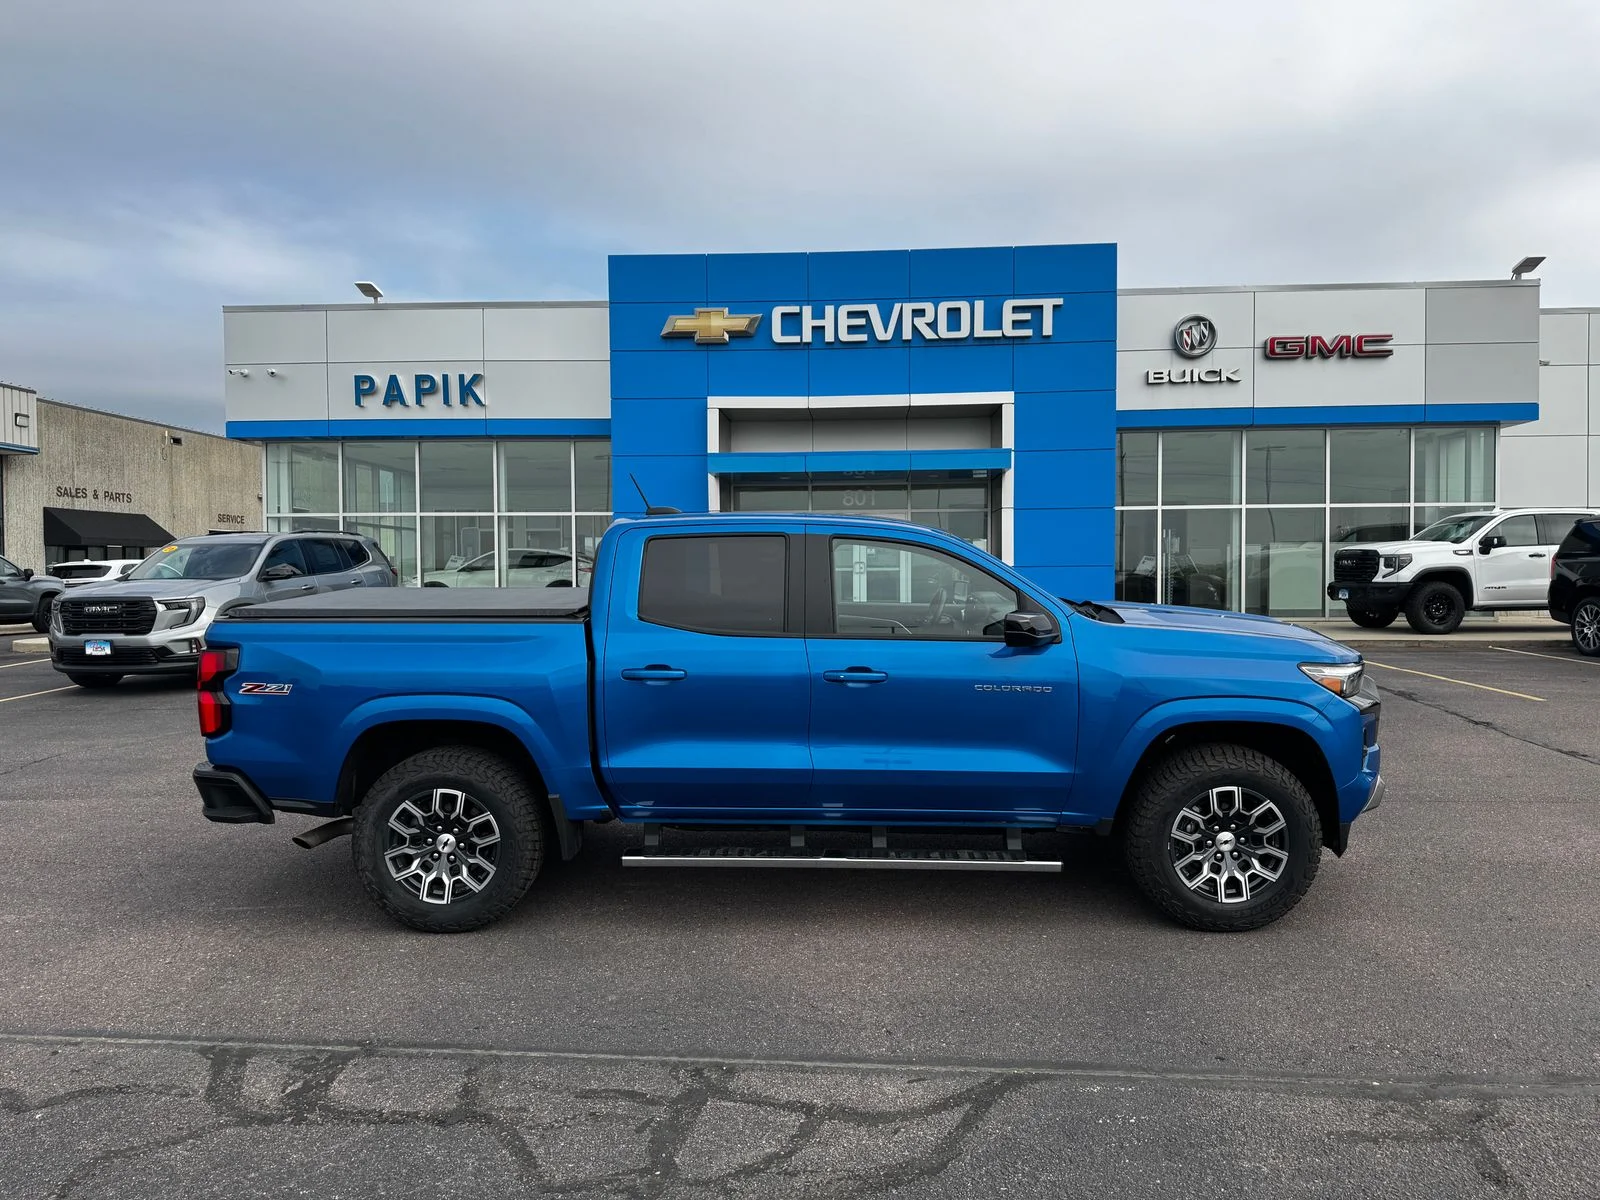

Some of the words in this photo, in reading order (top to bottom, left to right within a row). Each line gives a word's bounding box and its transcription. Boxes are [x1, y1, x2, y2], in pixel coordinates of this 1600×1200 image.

[771, 298, 1064, 344] CHEVROLET
[1264, 333, 1394, 360] GMC
[1146, 367, 1241, 385] BUICK
[354, 374, 485, 408] PAPIK
[56, 487, 87, 498] SALES
[92, 490, 99, 500] &
[103, 491, 132, 503] PARTS
[217, 514, 245, 524] SERVICE
[974, 683, 1053, 693] COLORADO
